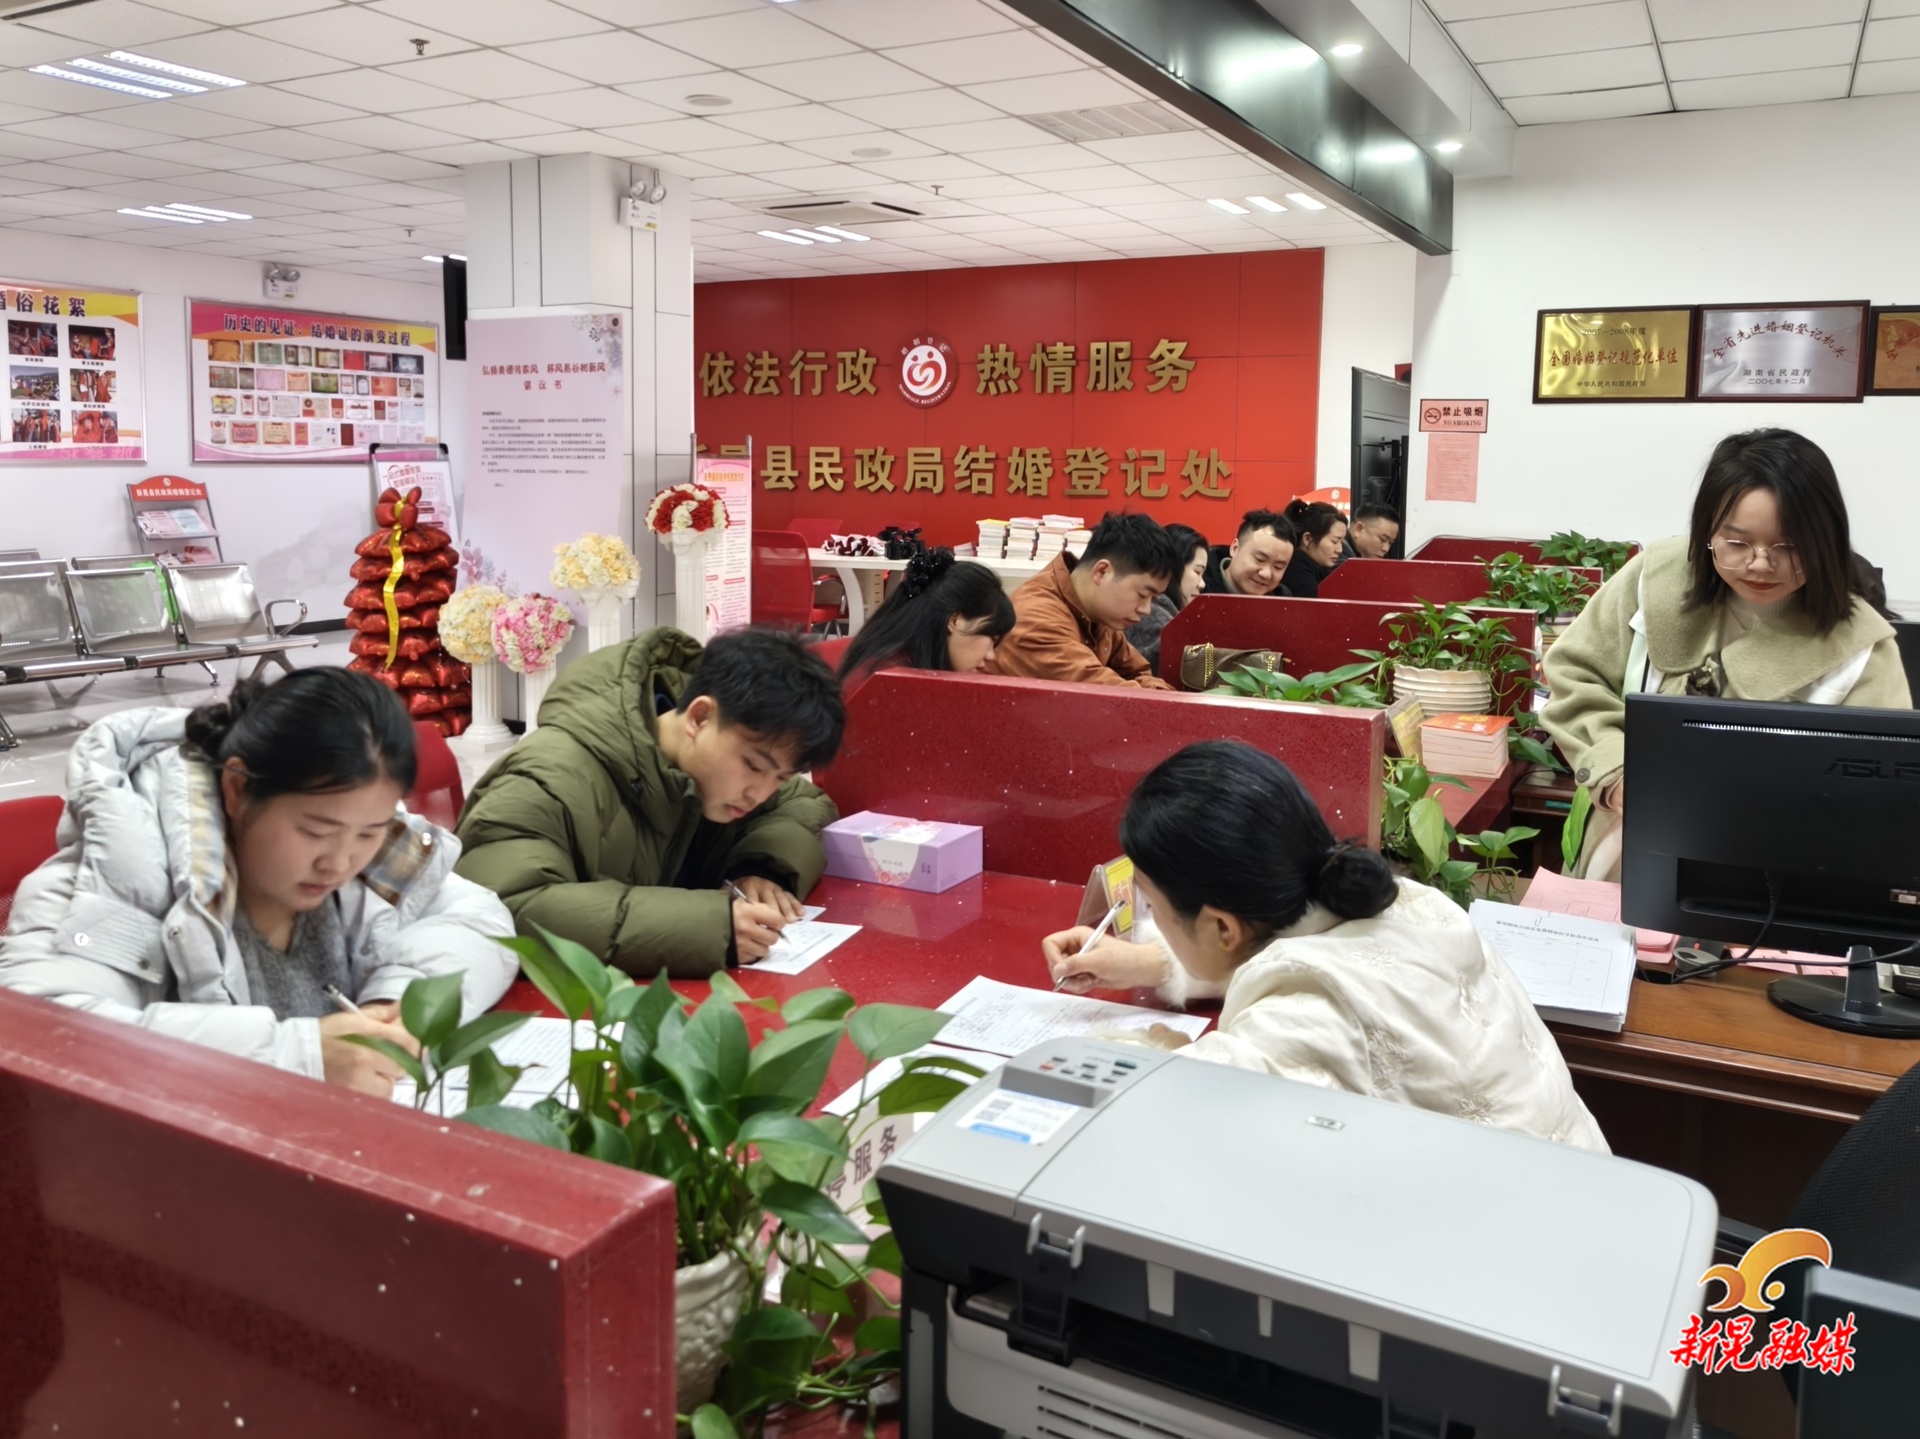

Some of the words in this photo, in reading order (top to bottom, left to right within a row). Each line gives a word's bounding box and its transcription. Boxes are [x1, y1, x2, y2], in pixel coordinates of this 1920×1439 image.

[1711, 320, 1848, 361] 全省先进婚姻登记机关
[1549, 347, 1679, 367] 全国婚姻登记规范化单位
[698, 348, 878, 398] 依法行政
[975, 338, 1197, 396] 热情服务
[1742, 368, 1813, 377] 湖南省民政厅
[1576, 380, 1647, 388] 中华人民共和国民政部
[1442, 406, 1484, 418] 禁止吸烟
[694, 444, 1233, 499] 县民政局结婚登记处
